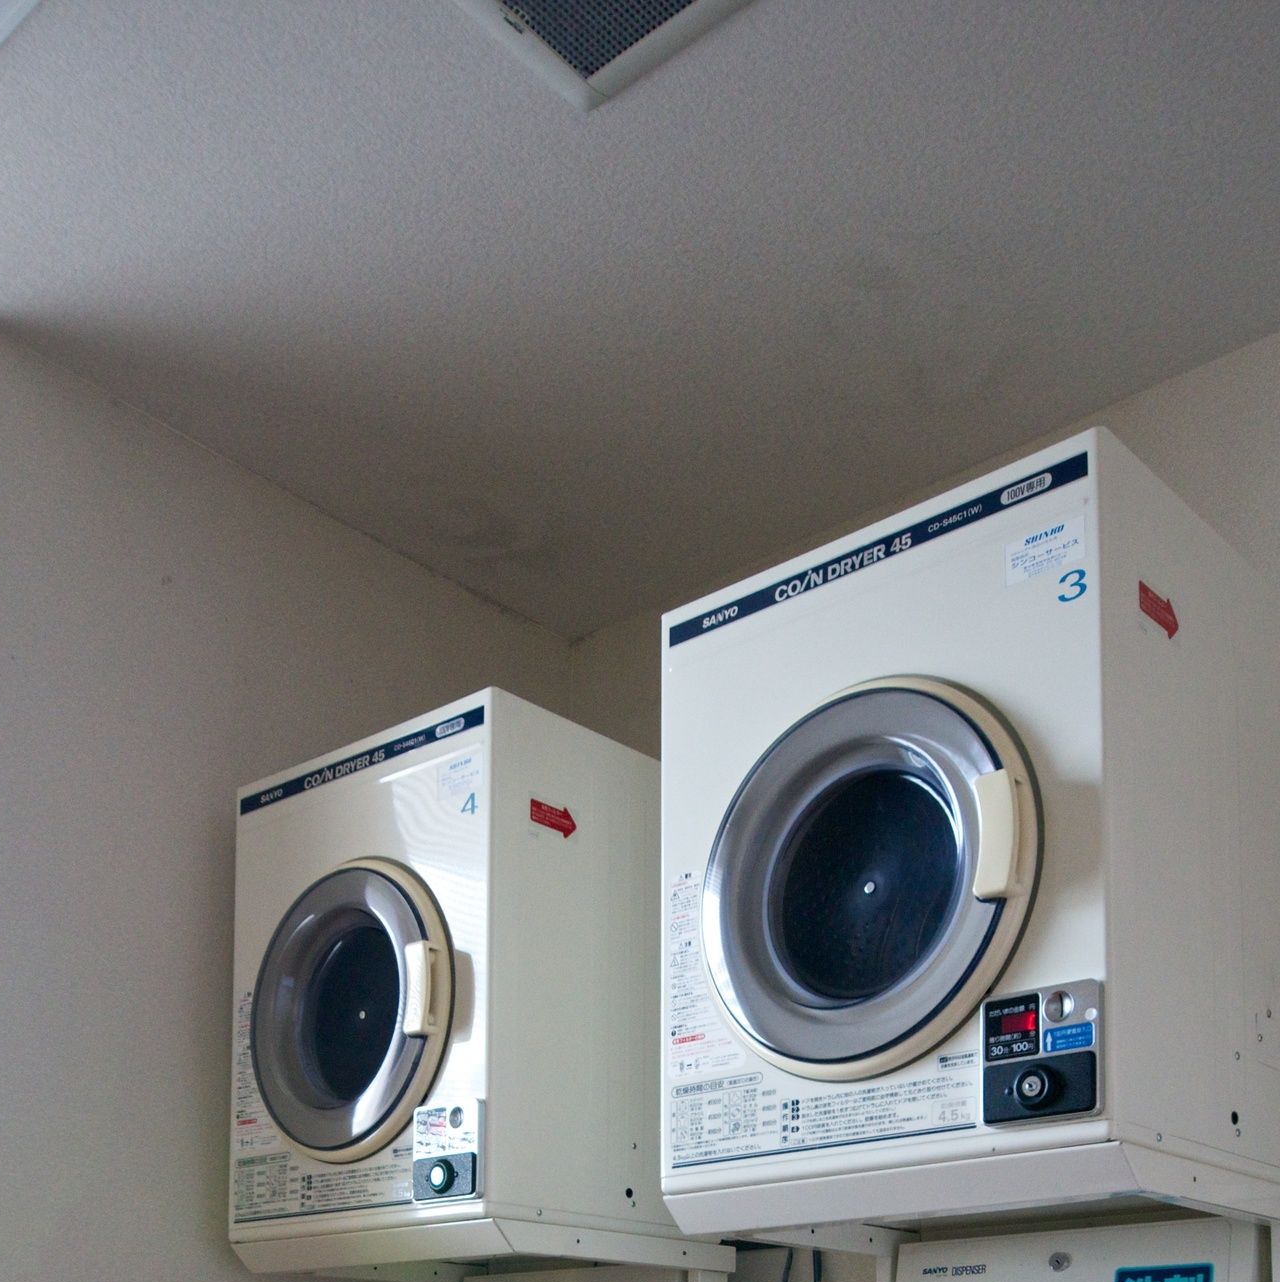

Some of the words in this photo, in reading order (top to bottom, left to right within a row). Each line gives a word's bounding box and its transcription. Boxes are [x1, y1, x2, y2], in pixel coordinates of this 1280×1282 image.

[702, 606, 738, 628] SANYO
[827, 545, 886, 579] DRYER
[890, 533, 912, 553] 45
[1058, 568, 1088, 602] 3
[335, 755, 370, 778] DRYER
[372, 749, 385, 763] 45
[460, 792, 479, 815] 4
[922, 1267, 948, 1275] SANYO
[951, 1264, 986, 1276] DISPENSER
